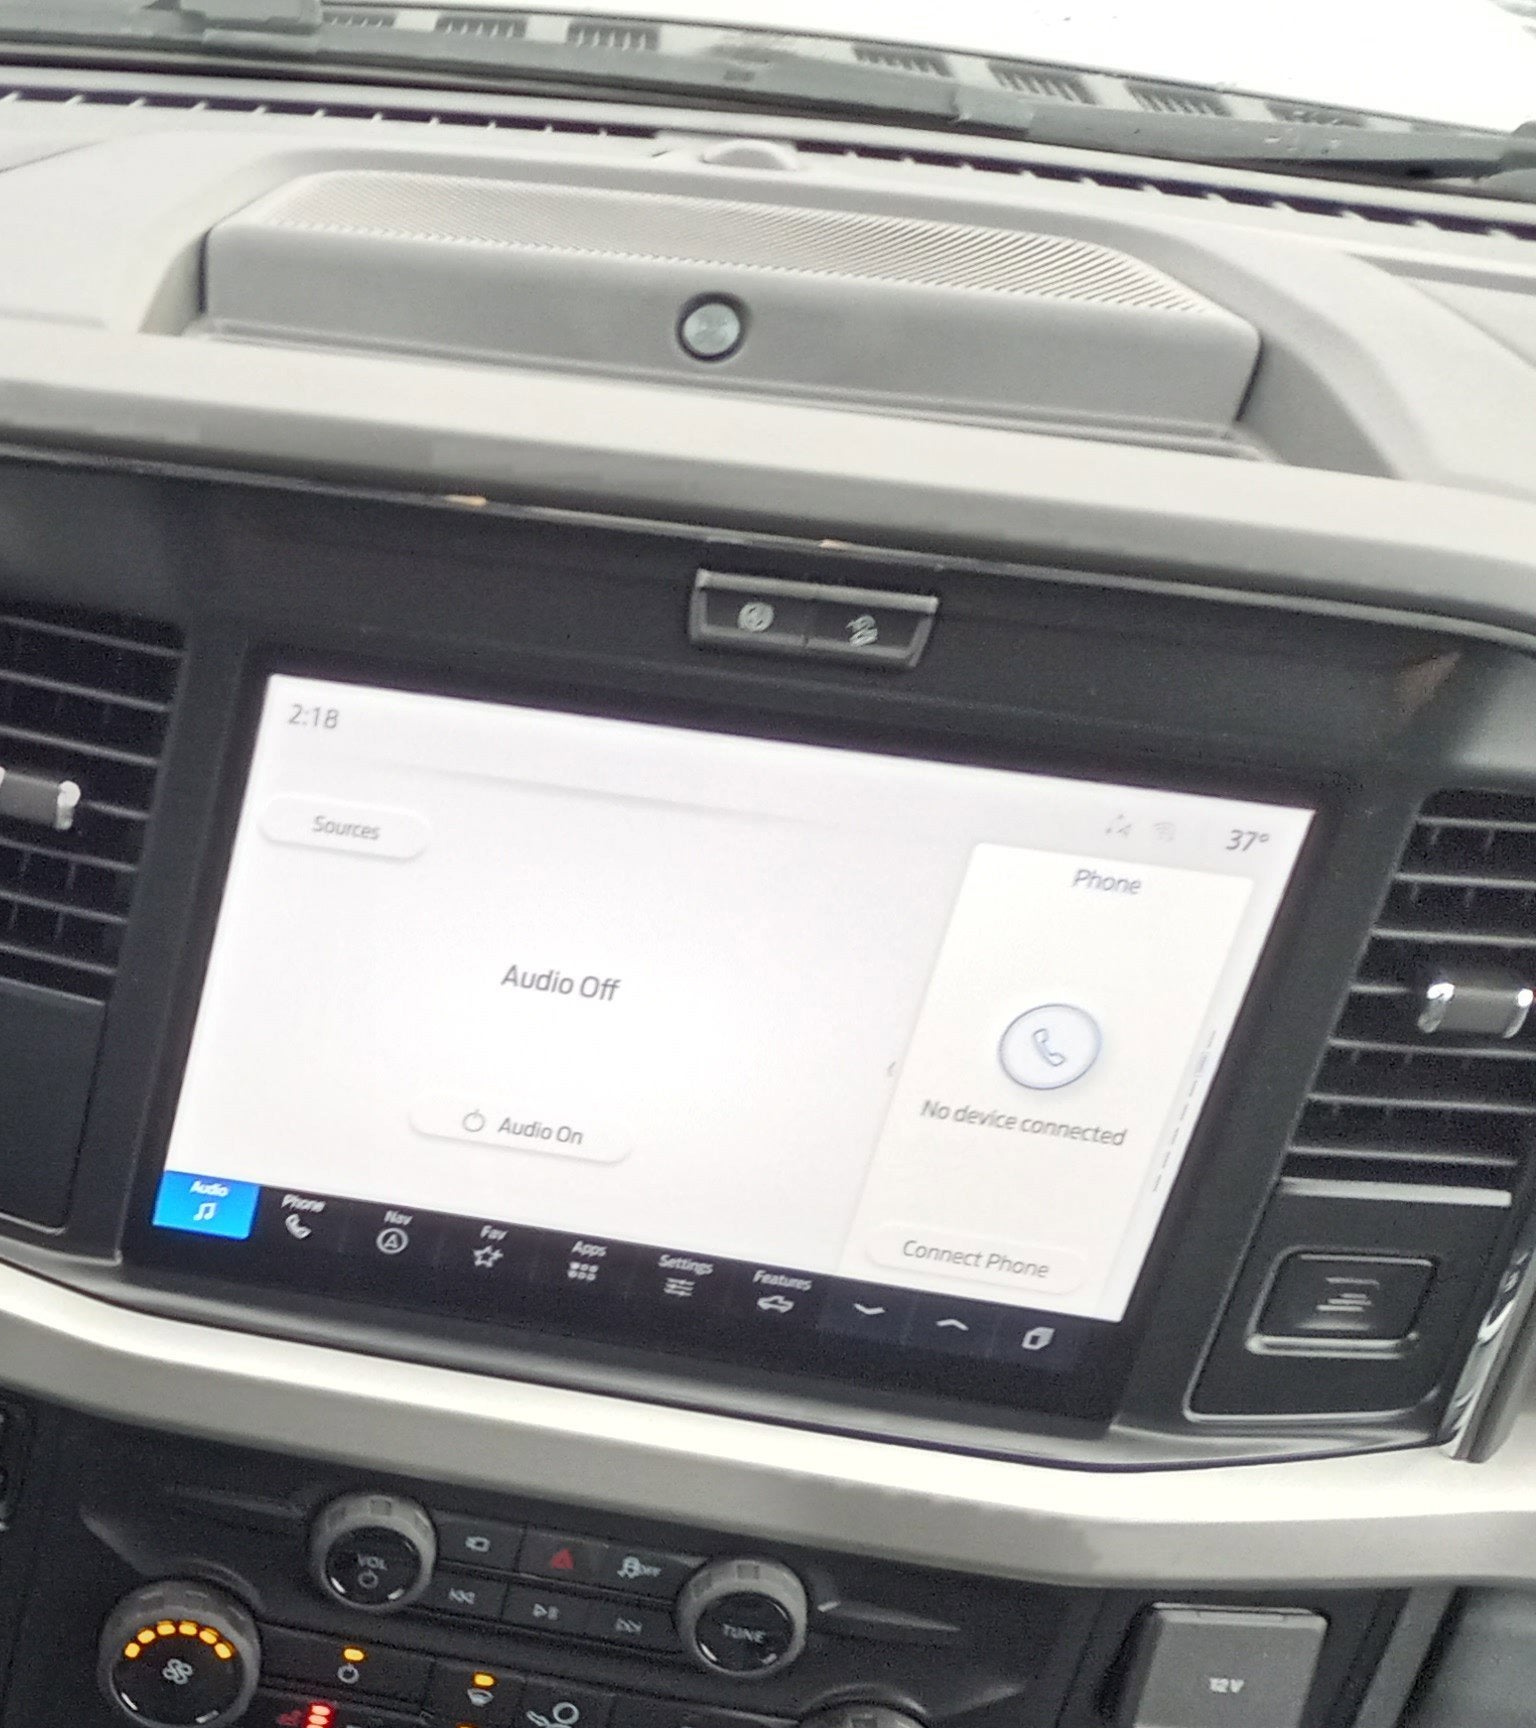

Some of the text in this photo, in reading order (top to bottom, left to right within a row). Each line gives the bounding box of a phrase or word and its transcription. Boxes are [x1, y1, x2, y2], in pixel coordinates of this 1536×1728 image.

[288, 703, 341, 731] 2:18
[312, 814, 381, 842] Sources
[1072, 868, 1143, 896] Phone
[500, 964, 623, 1001] Audio Off
[497, 1116, 585, 1146] Audio On
[920, 1099, 1128, 1147] No device connected
[189, 1180, 230, 1199] Audio
[281, 1193, 327, 1214] Phone
[383, 1210, 414, 1227] Nav
[479, 1225, 508, 1242] Fav
[571, 1240, 607, 1258] Apps
[901, 1239, 1051, 1280] Connect Phone
[658, 1254, 714, 1277] Settings
[753, 1269, 813, 1292] Features
[355, 1552, 389, 1573] VOL
[721, 1622, 767, 1645] TUNE
